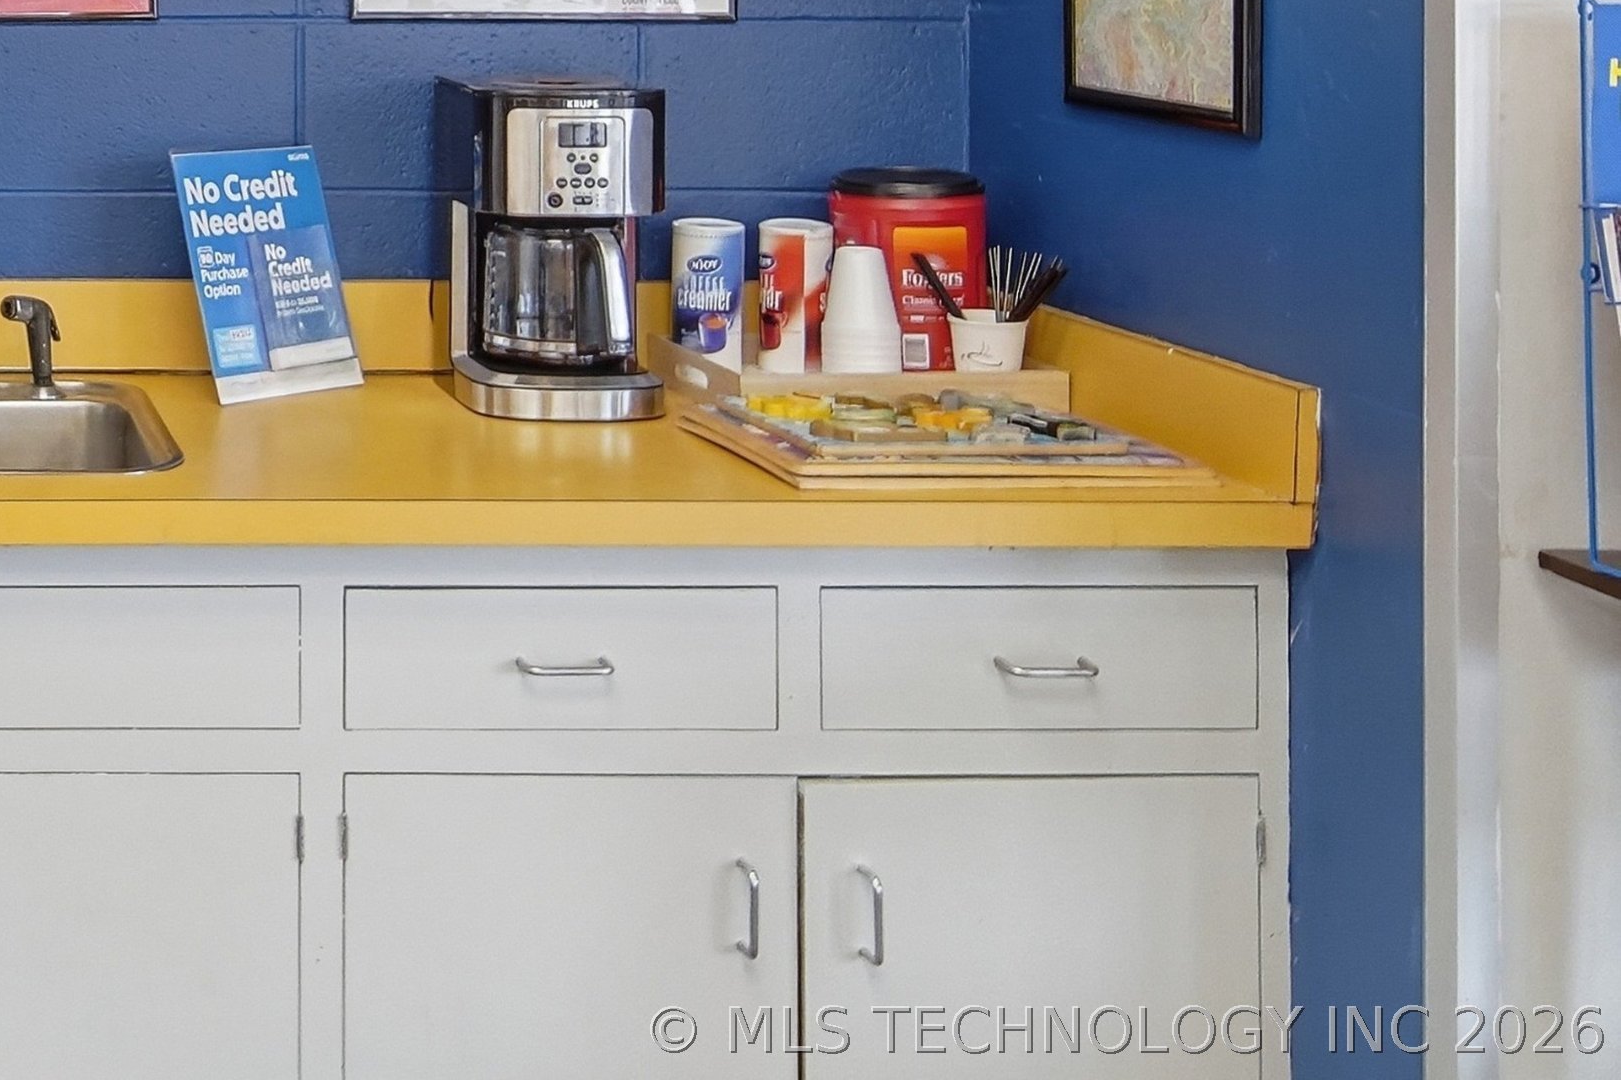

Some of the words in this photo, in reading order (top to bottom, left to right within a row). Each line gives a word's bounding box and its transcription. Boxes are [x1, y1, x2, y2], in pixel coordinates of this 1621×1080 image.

[183, 176, 221, 206] No
[223, 169, 298, 203] Credit
[189, 202, 286, 238] Needed
[214, 251, 236, 267] Day
[264, 243, 287, 261] No
[200, 266, 249, 283] Purchase
[267, 256, 314, 278] Credit
[203, 283, 242, 300] Option
[271, 271, 333, 296] Needed
